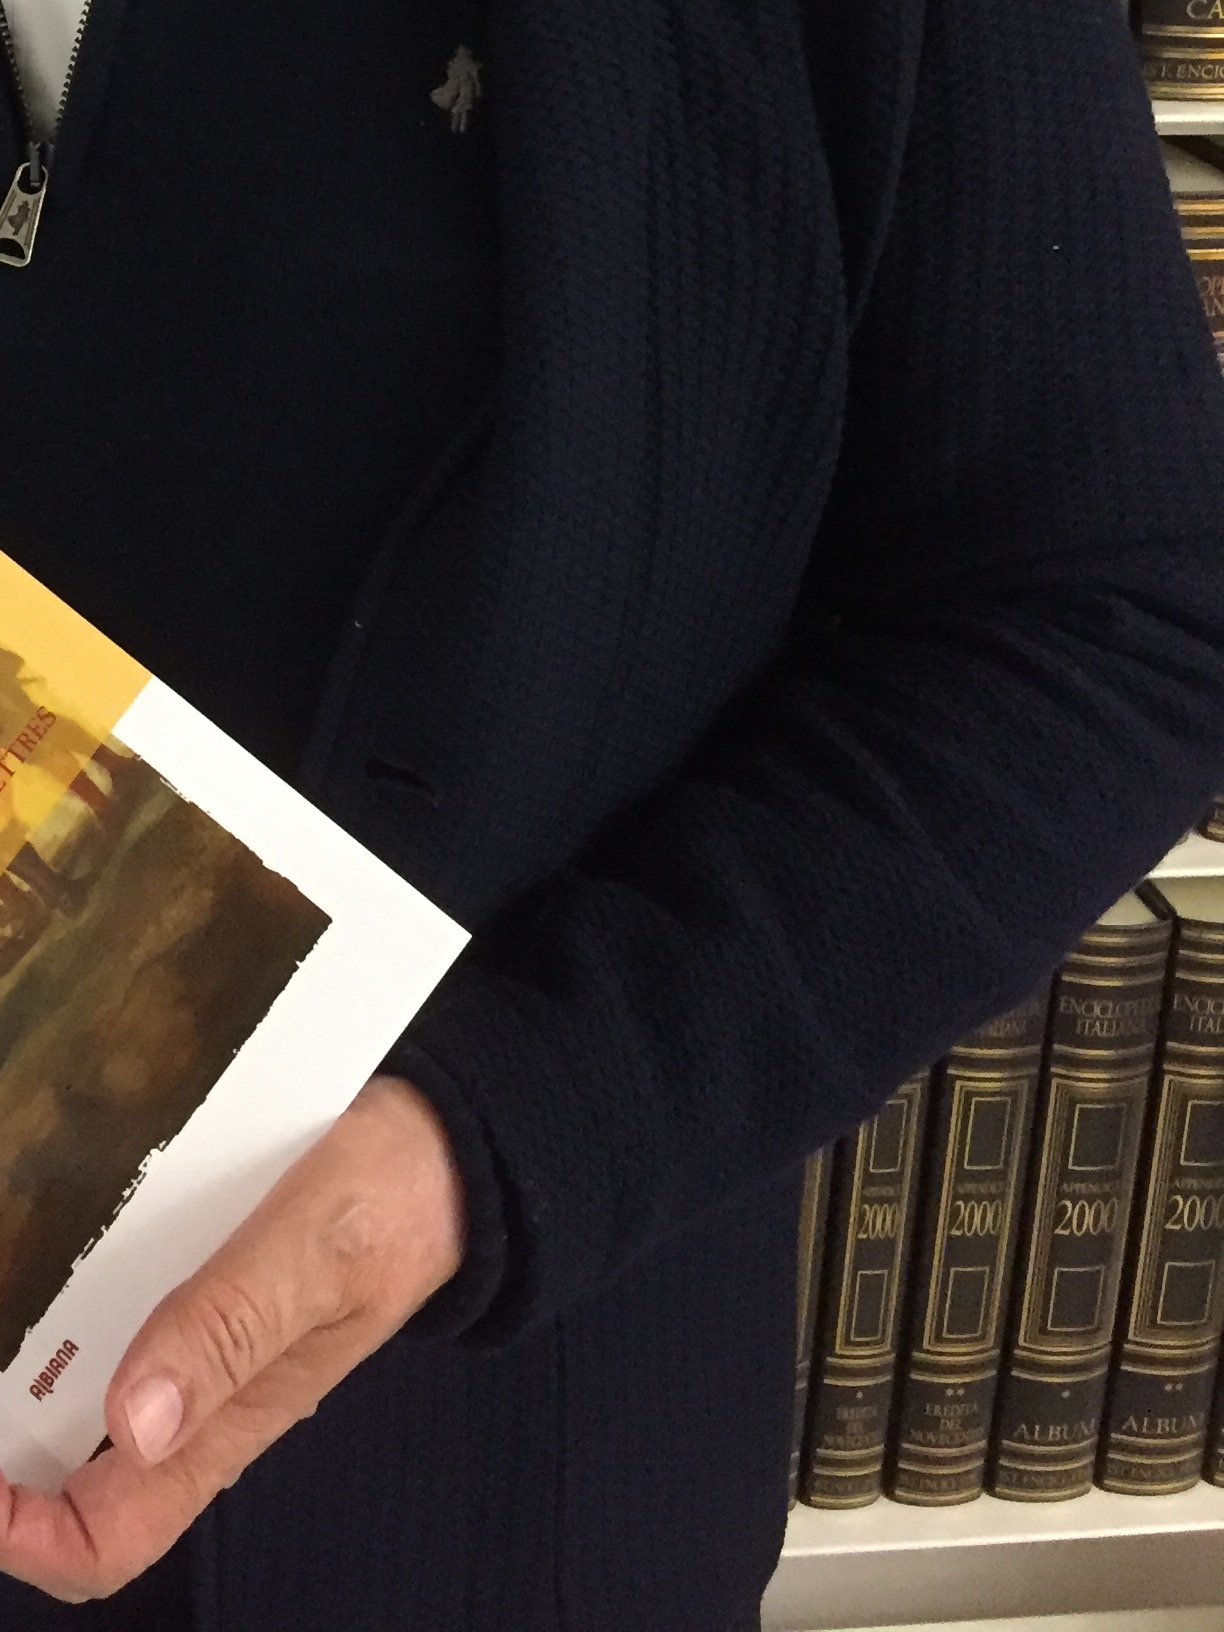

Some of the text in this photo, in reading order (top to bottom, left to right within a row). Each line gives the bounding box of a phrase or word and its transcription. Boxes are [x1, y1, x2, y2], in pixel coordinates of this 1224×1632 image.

[857, 1203, 899, 1240] 2000
[949, 1200, 1003, 1237] 2000
[1054, 1197, 1119, 1237] 2000
[1013, 1418, 1096, 1441] ALBUM
[1122, 1412, 1206, 1434] ALBUM
